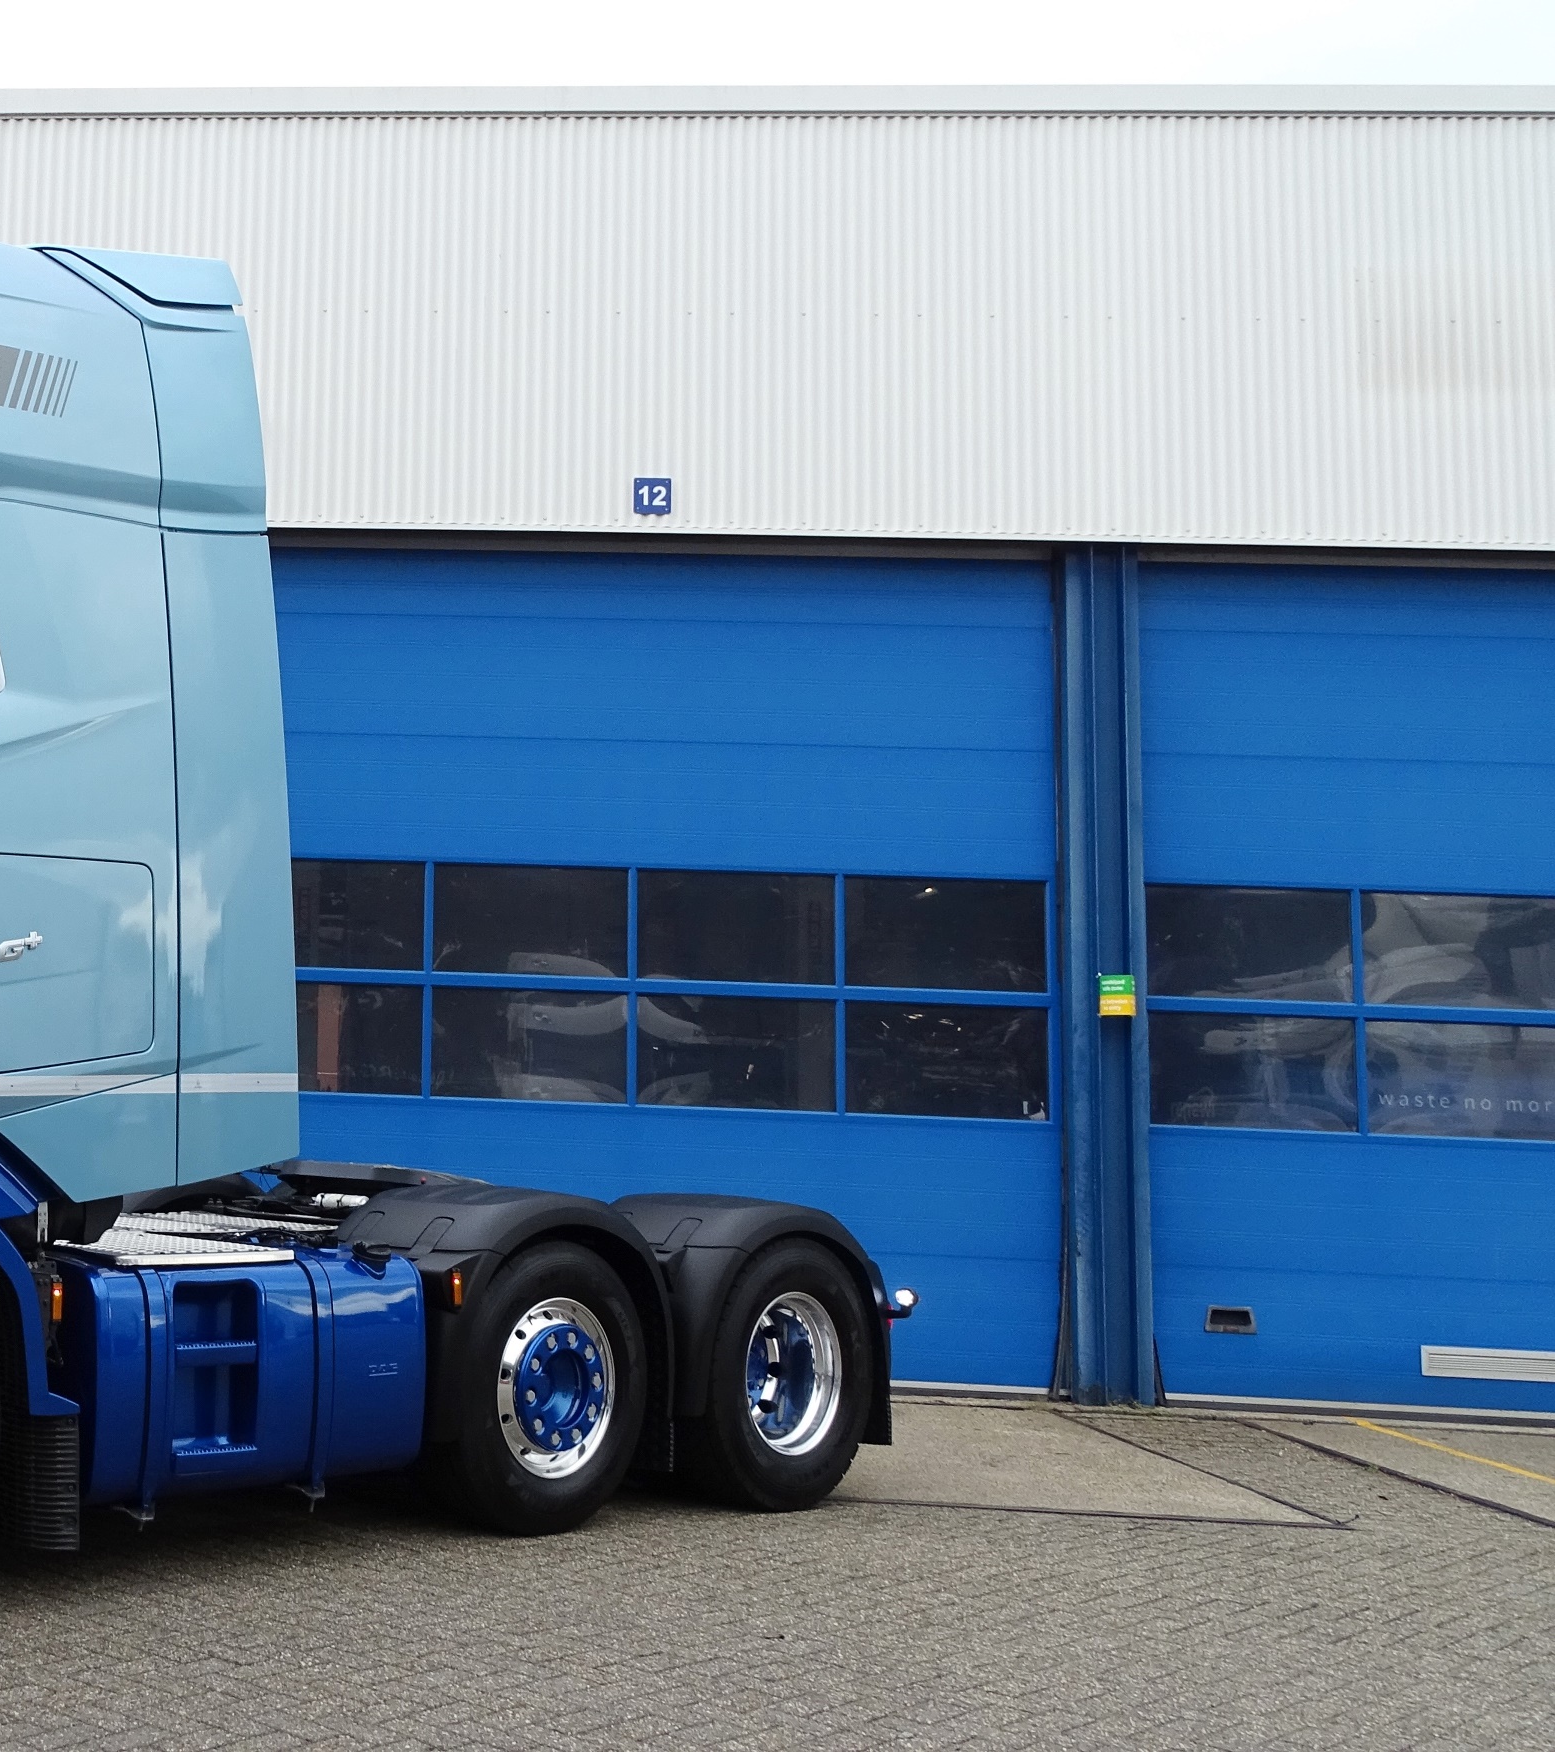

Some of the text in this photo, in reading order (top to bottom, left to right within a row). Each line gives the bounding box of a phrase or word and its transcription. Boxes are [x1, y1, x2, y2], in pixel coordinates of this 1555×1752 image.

[638, 485, 667, 506] 12
[1378, 1093, 1451, 1109] waste
[1464, 1097, 1492, 1111] no
